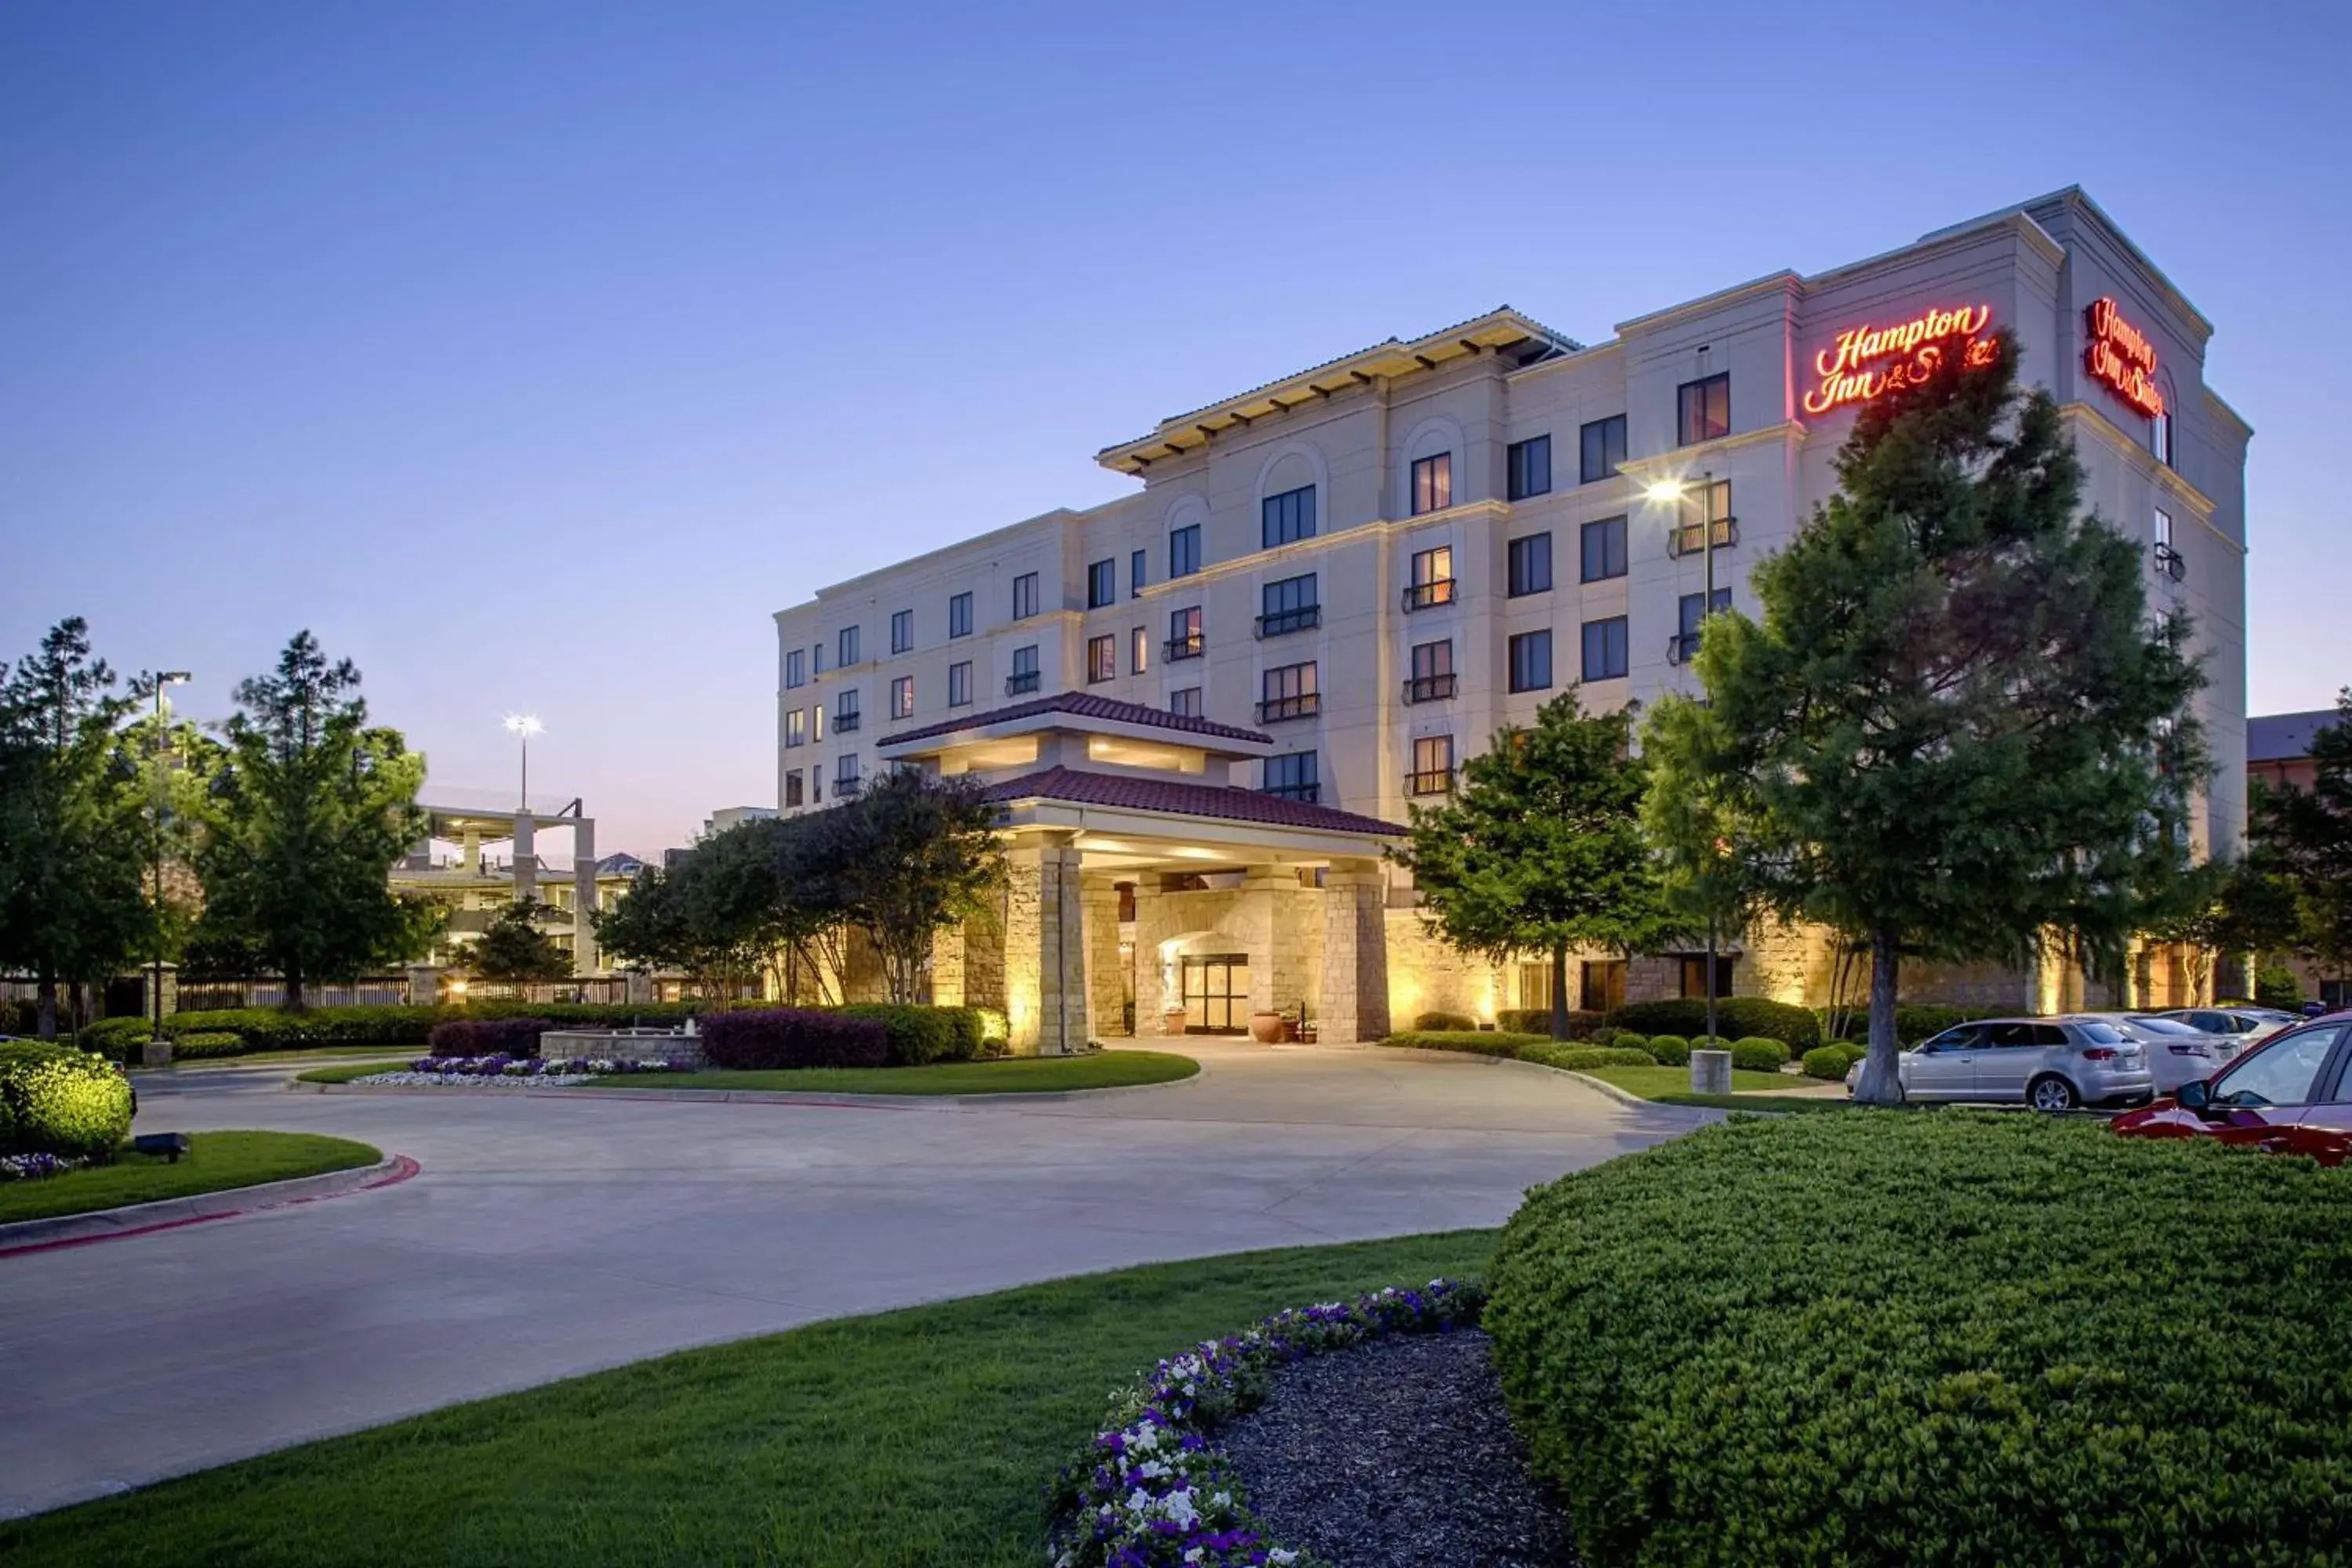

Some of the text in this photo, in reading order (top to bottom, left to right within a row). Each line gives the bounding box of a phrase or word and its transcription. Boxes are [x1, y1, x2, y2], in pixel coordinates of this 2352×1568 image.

[1817, 304, 1989, 376] Hampton
[2094, 340, 2126, 390] Inn
[2095, 297, 2156, 374] Hampton
[1805, 371, 1886, 412] Inn
[1886, 363, 1907, 389] &
